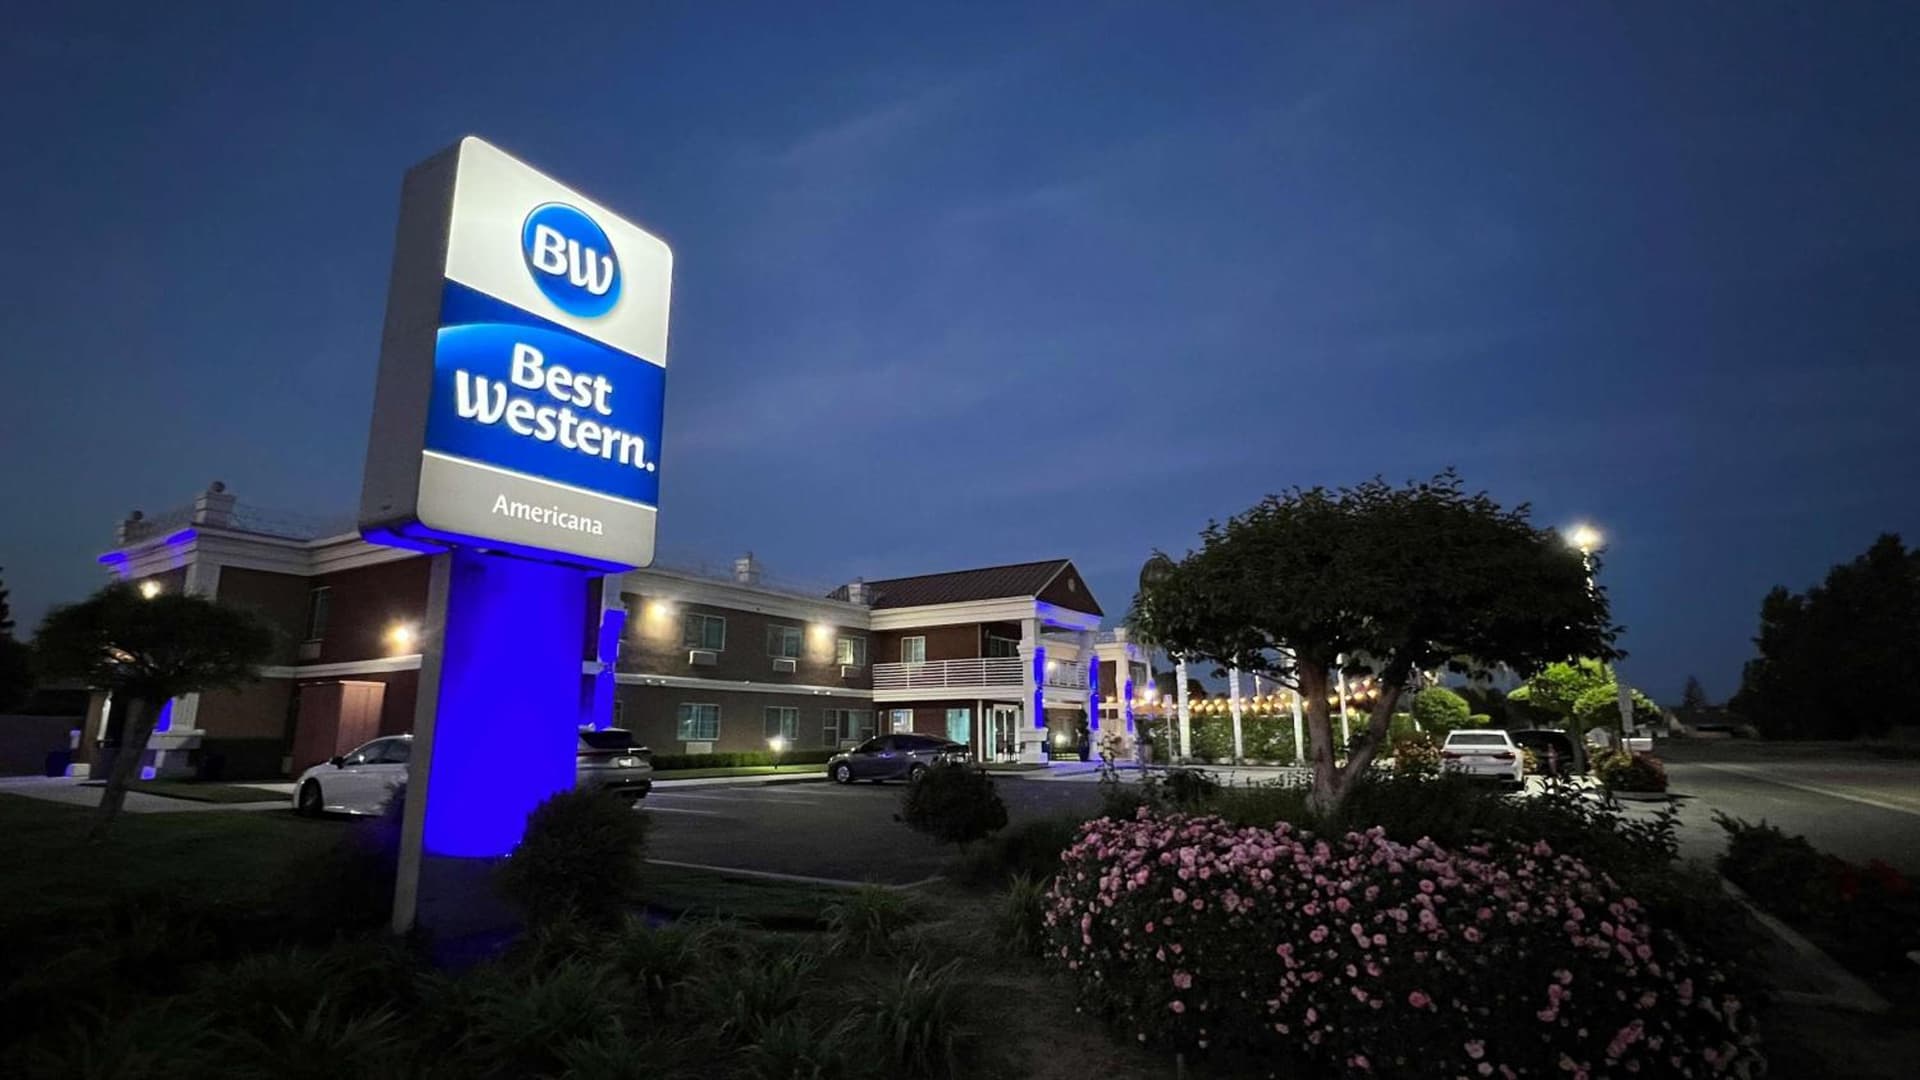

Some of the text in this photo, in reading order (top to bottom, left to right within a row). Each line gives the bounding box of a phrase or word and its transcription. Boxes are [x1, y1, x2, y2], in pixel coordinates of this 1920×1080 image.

[532, 224, 614, 295] BW
[511, 342, 613, 415] Best
[492, 494, 604, 536] Americana
